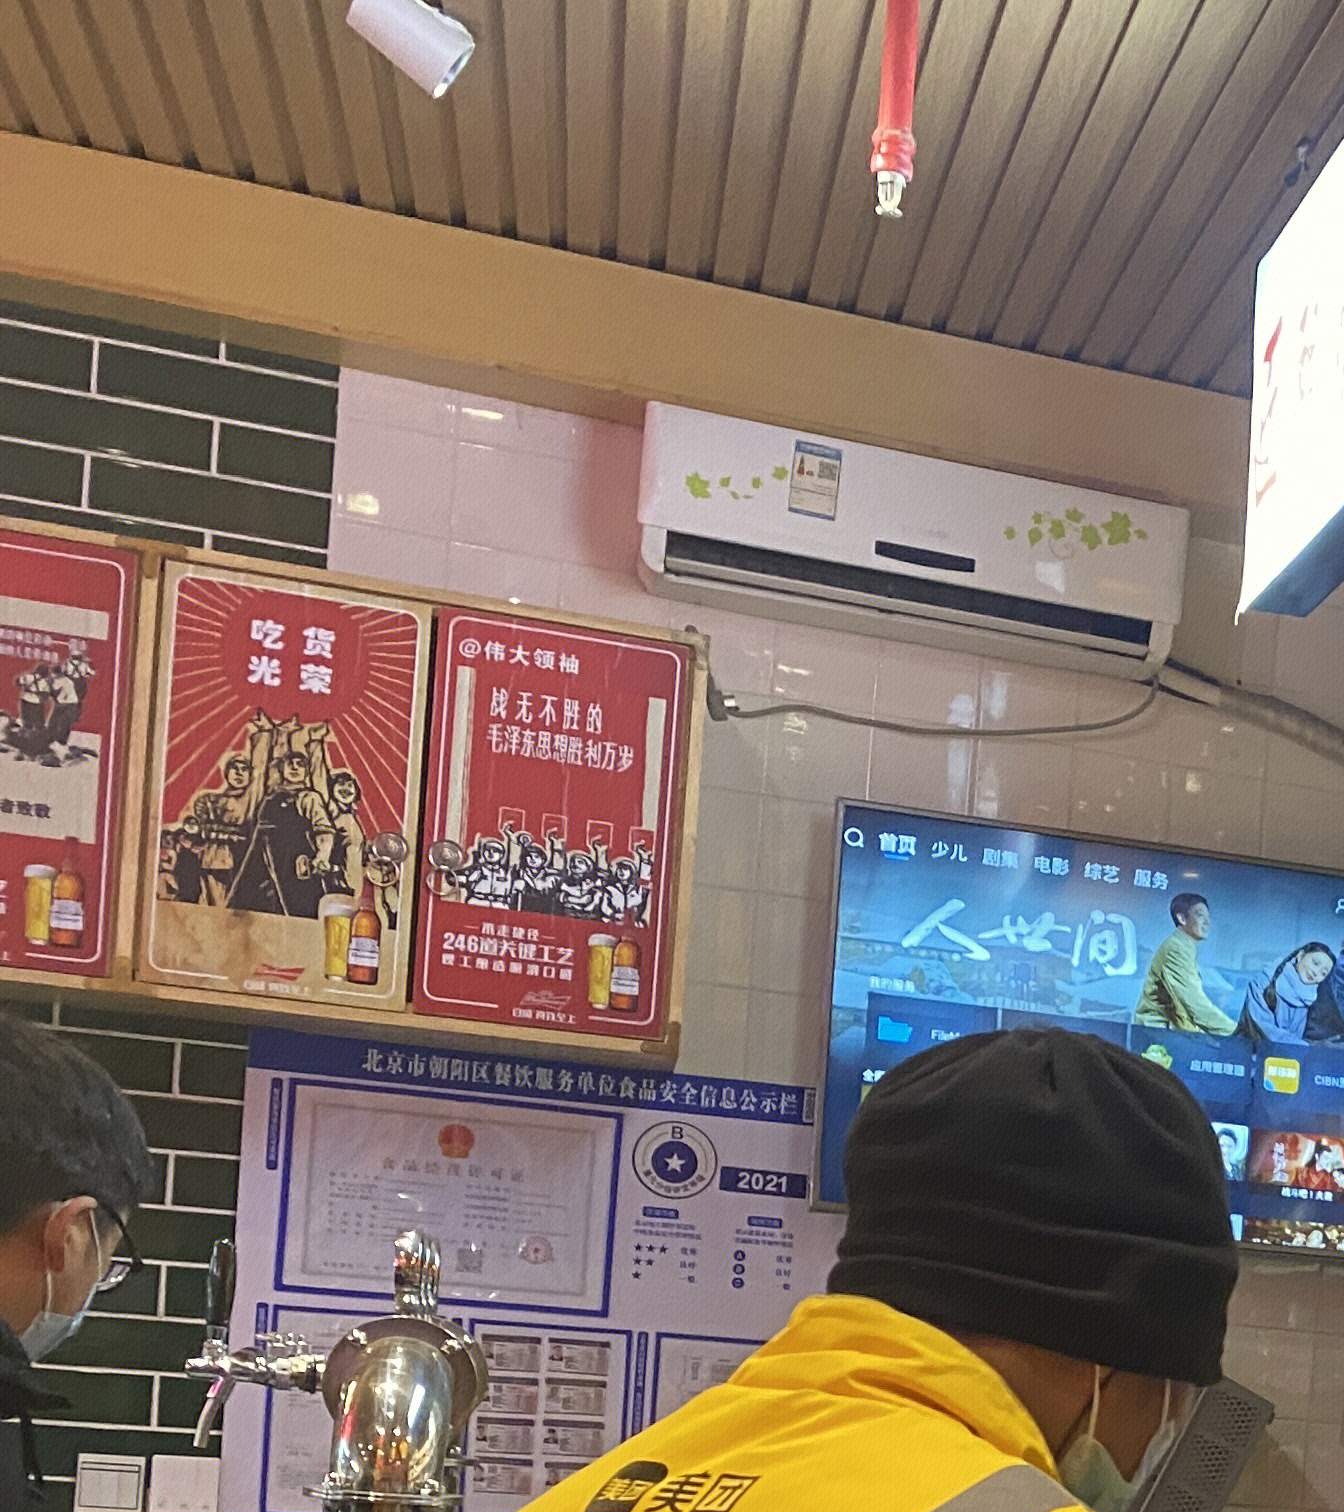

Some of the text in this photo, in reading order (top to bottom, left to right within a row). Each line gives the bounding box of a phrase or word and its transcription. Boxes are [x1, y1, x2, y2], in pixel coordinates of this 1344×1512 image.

[249, 617, 339, 661] 吃货
[458, 637, 581, 676] @伟大领袖
[247, 654, 335, 697] 光荣
[489, 685, 604, 736] 战无不胜的
[486, 722, 635, 774] 毛泽东思想胜利万岁
[878, 832, 1170, 891] 首页 少儿 剧集 电影 综艺 服务
[442, 931, 576, 968] 246道关键工艺
[900, 898, 1138, 977] 人世间
[670, 1125, 685, 1141] B
[736, 1171, 789, 1194] 2021
[597, 1476, 654, 1505] 美团
